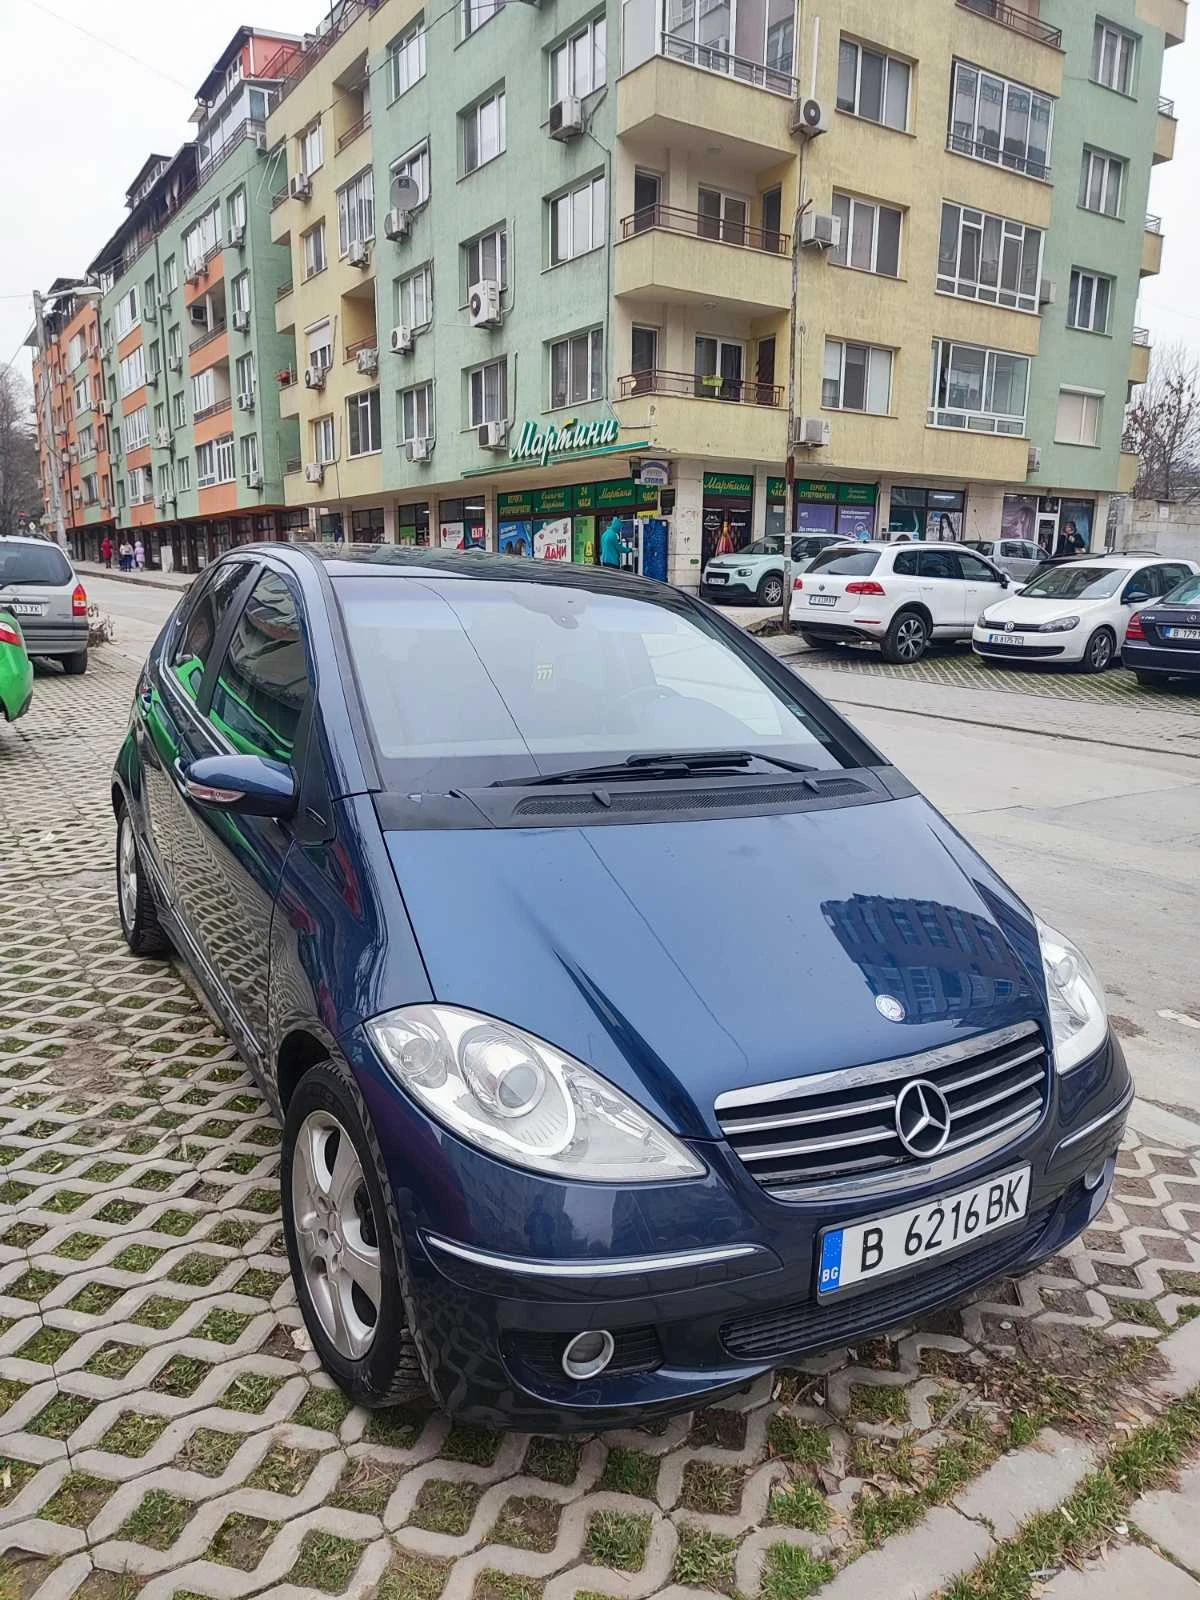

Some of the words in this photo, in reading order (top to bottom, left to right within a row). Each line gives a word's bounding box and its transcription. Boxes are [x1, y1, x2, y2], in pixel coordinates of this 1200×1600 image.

[509, 418, 619, 466] Мартини
[703, 476, 752, 494] Мартини
[861, 1227, 884, 1273] B
[904, 1193, 980, 1257] 6216
[985, 1174, 1024, 1226] BK
[821, 1266, 839, 1283] BG
